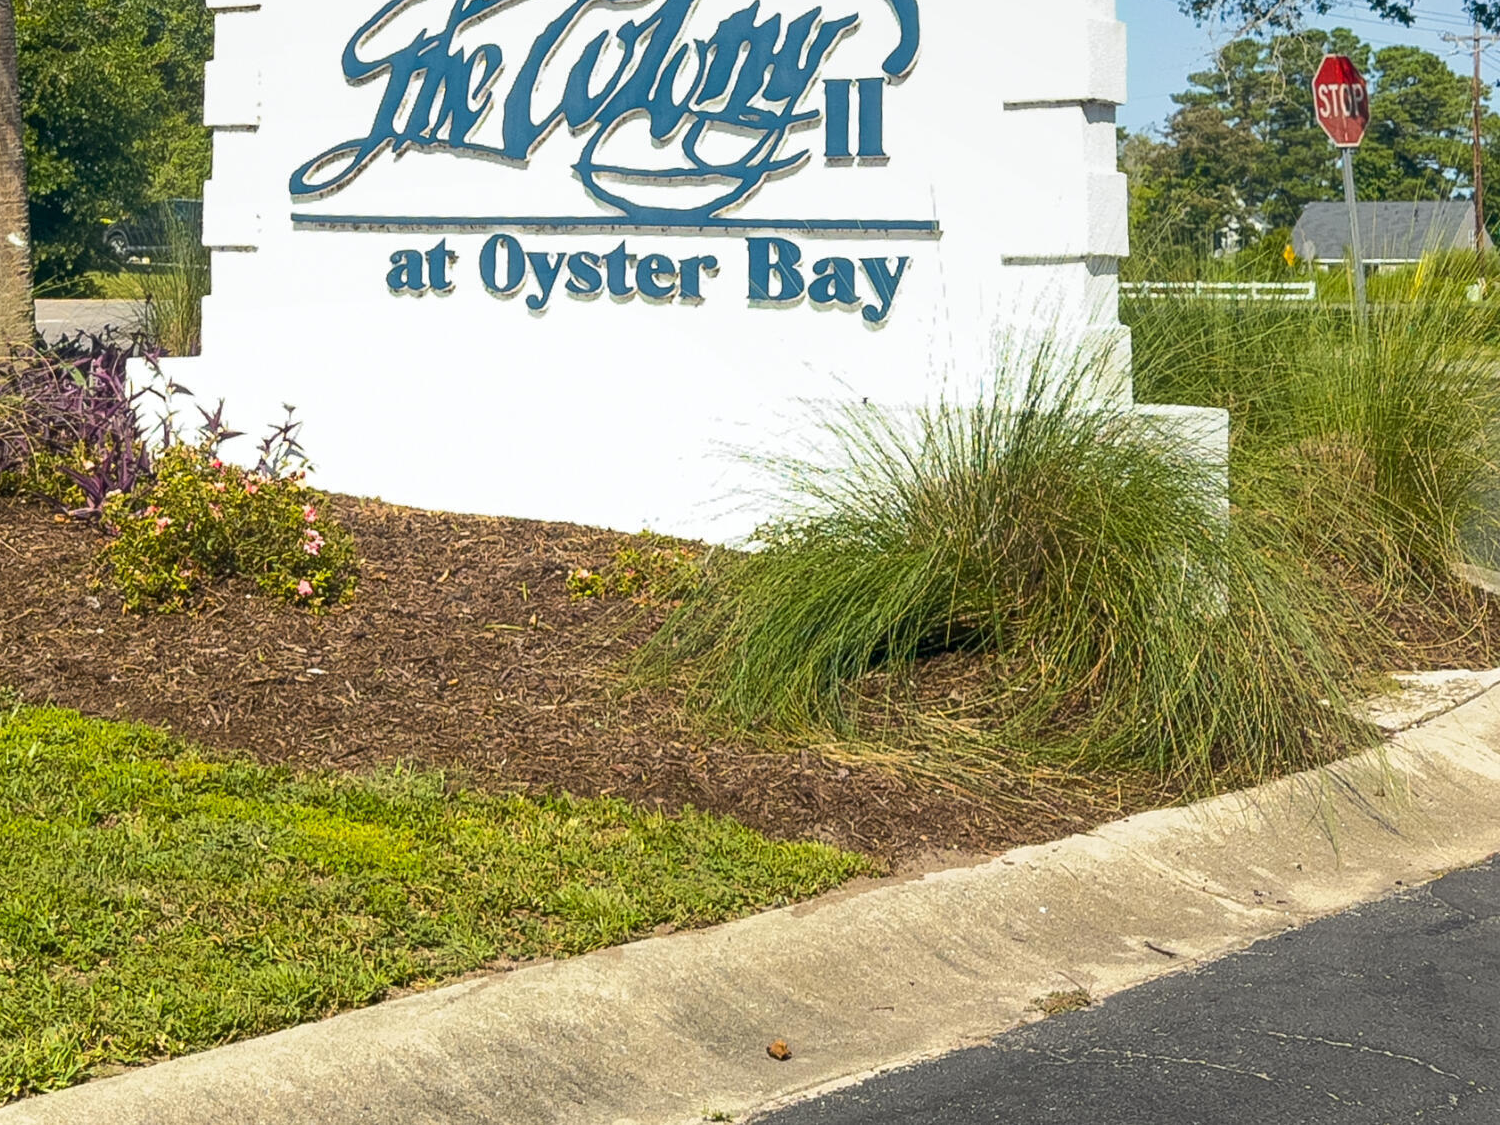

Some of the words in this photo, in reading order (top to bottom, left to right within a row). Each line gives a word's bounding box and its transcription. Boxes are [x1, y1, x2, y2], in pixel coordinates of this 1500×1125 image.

[822, 77, 889, 161] II
[1318, 83, 1364, 118] STOP
[385, 238, 455, 295] at
[479, 233, 719, 311] Oyster
[744, 236, 911, 324] Bay
